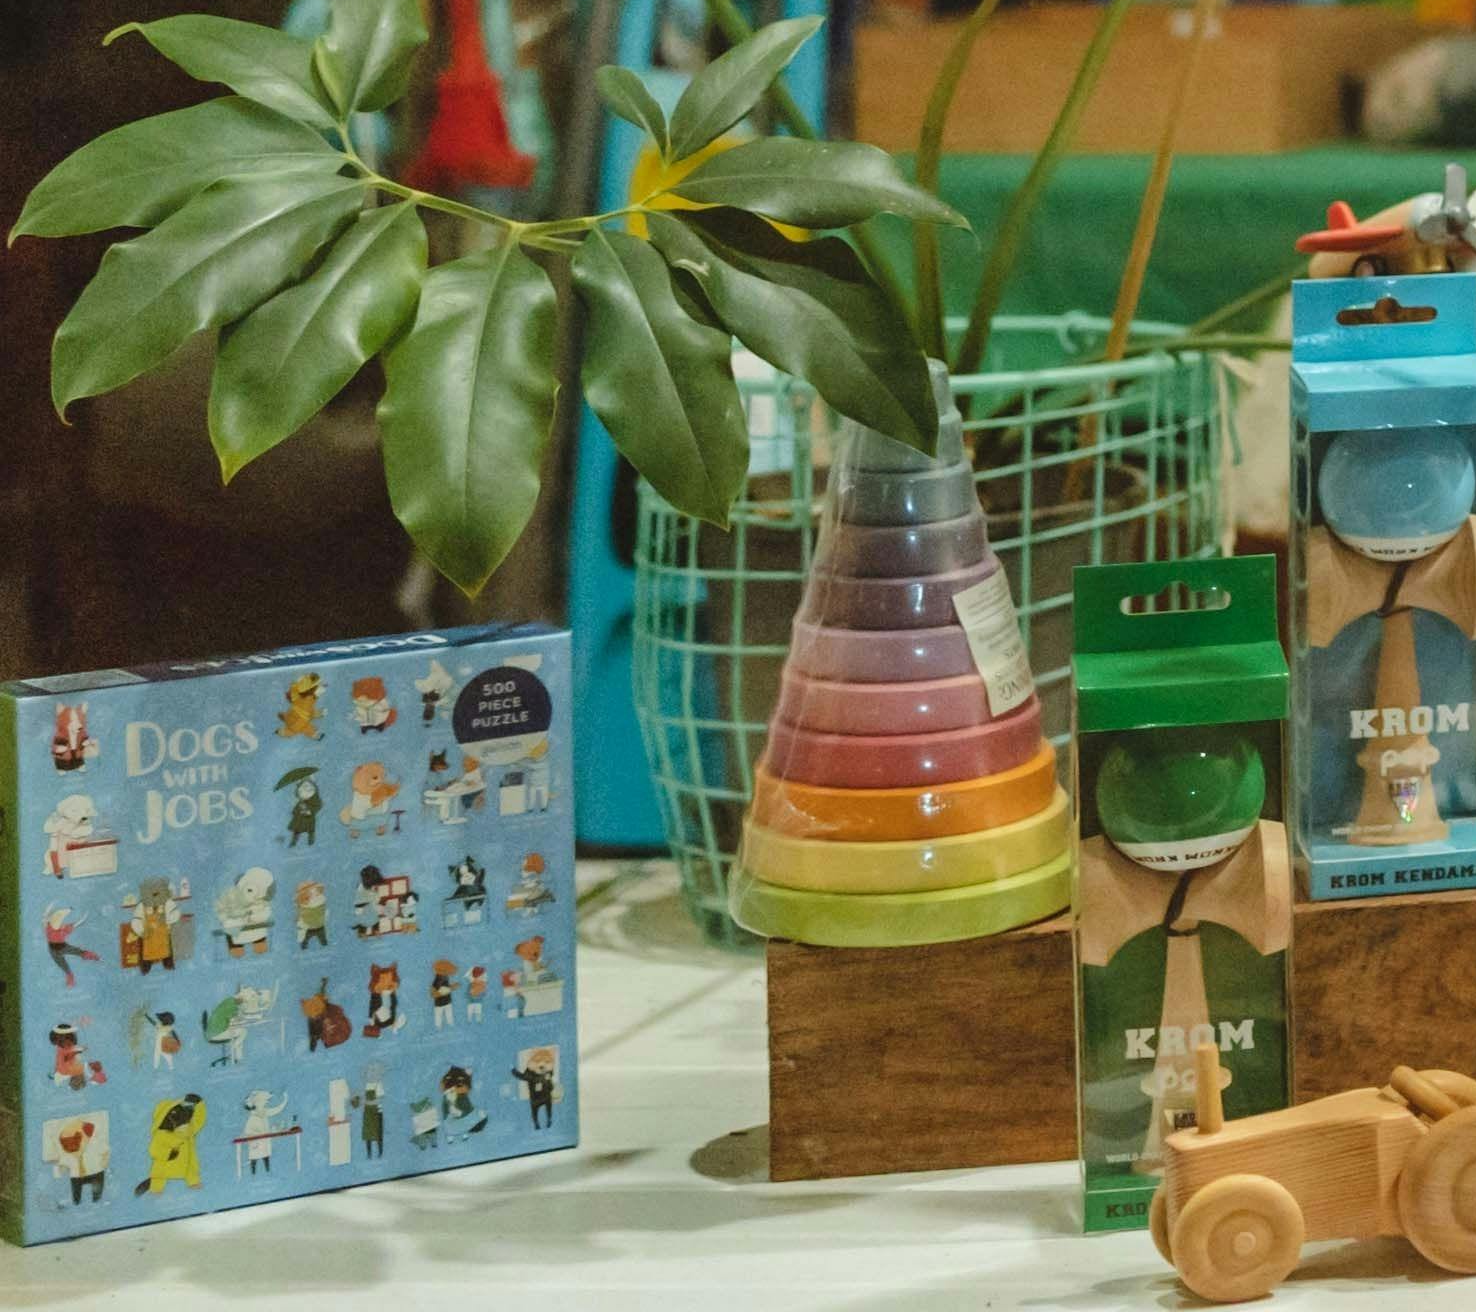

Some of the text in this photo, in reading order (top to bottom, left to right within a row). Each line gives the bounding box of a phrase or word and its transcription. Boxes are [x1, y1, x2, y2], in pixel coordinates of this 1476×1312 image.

[482, 680, 517, 697] 500
[478, 696, 522, 713] PIECE
[470, 710, 530, 729] PUZZLE
[1349, 702, 1471, 740] KROM
[124, 719, 260, 778] DOGS
[162, 762, 229, 789] WITH
[136, 785, 255, 846] JOBS
[1330, 872, 1386, 889] KROM
[1124, 1019, 1256, 1060] KROM
[1105, 1201, 1149, 1219] KRO
